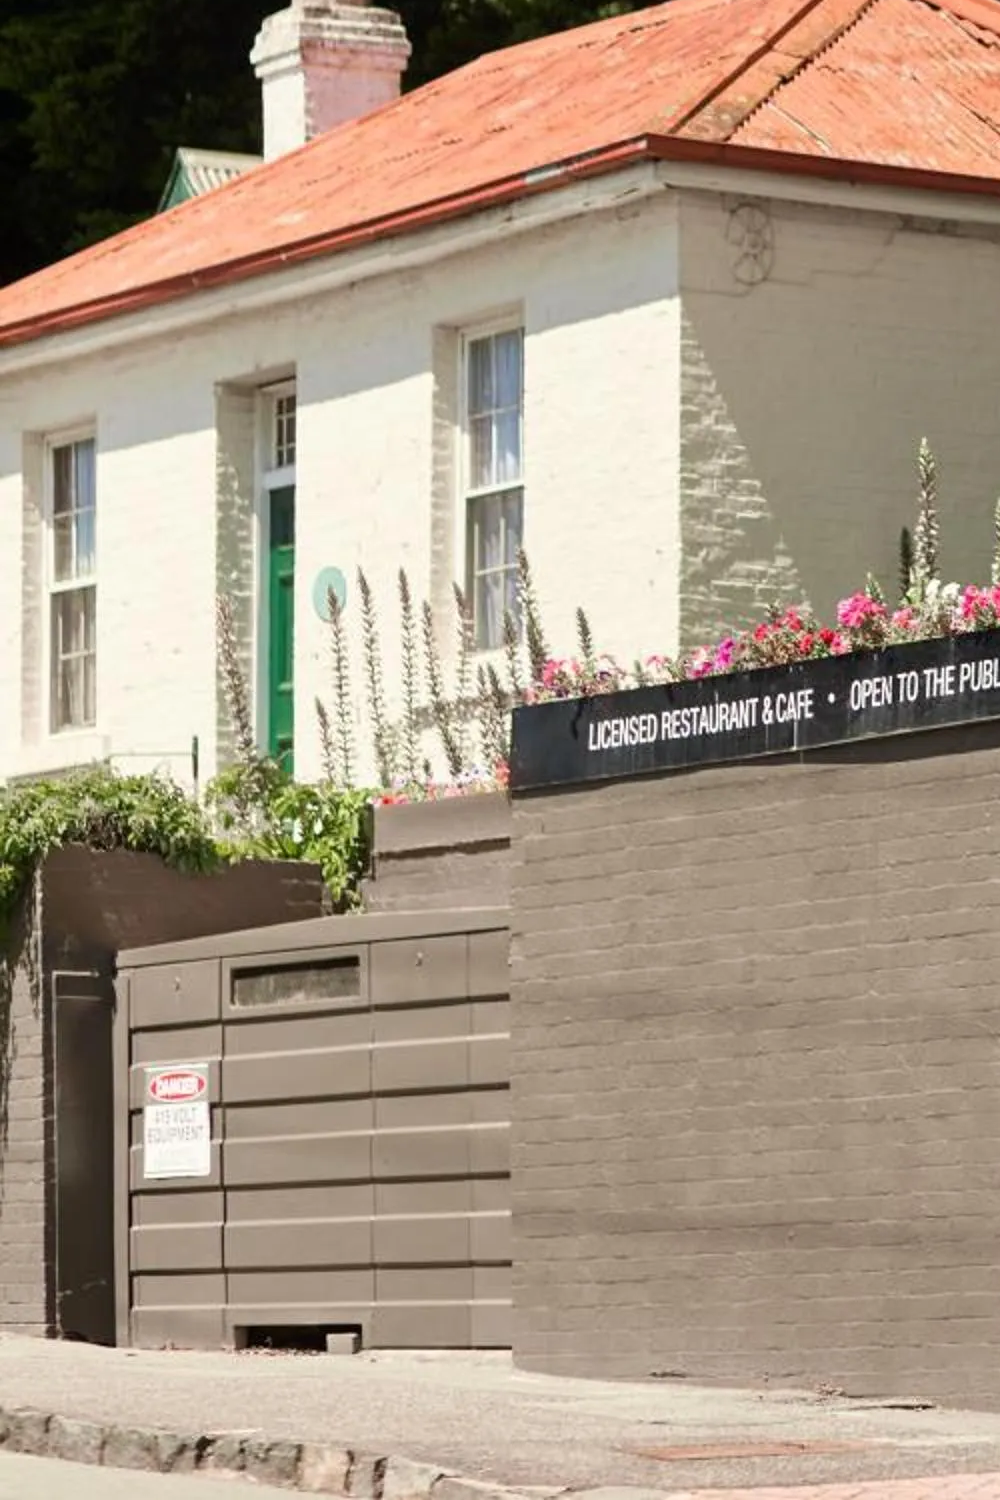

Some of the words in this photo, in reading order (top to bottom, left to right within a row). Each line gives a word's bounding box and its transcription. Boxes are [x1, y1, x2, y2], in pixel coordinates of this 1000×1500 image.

[588, 713, 658, 751] LICENSED
[660, 697, 760, 741] RESTAURANT
[761, 695, 774, 725] &
[774, 688, 815, 723] CAFE
[850, 675, 893, 712] OPEN
[897, 670, 920, 703] TO
[923, 665, 957, 699] THE
[147, 1124, 204, 1145] EQUIPMENT
